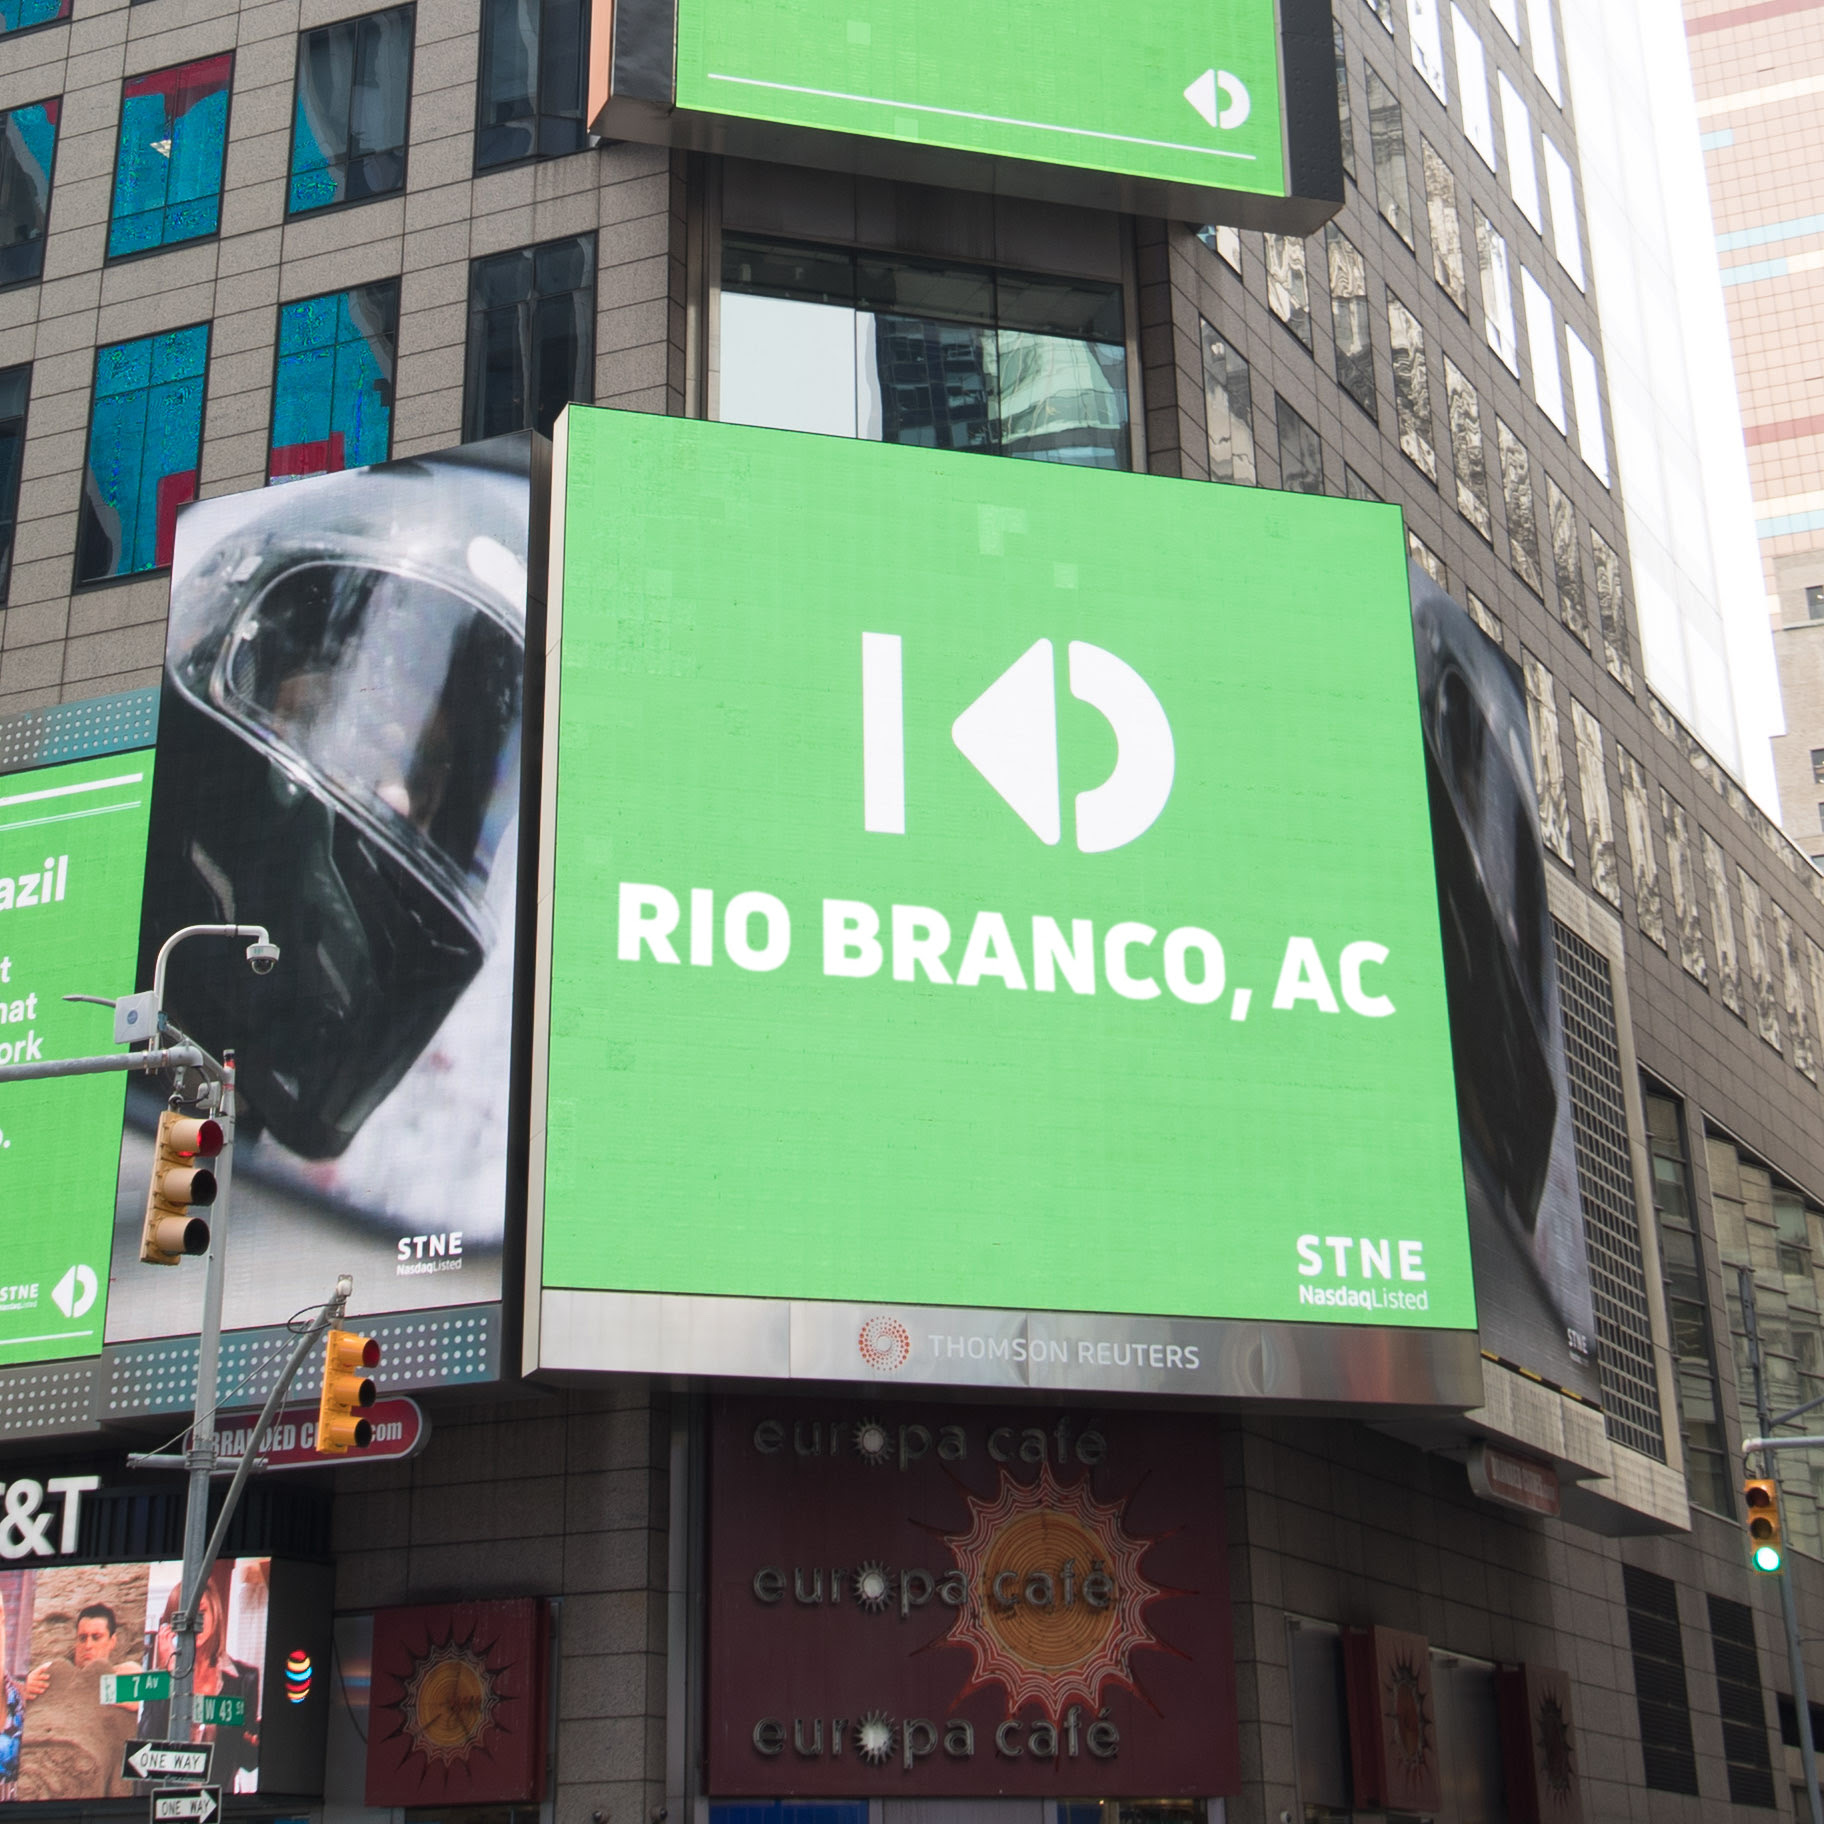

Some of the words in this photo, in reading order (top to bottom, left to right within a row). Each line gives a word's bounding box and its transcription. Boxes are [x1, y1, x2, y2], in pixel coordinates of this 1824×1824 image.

[617, 881, 792, 972] RIO
[822, 896, 1253, 1023] BRANCO,
[1271, 935, 1398, 1019] AC
[396, 1232, 463, 1261] STNE
[1296, 1233, 1428, 1282] STNE
[395, 1258, 463, 1277] NasdaqListed
[0, 1283, 40, 1302] STNE
[1298, 1283, 1430, 1312] NasdaqListed
[927, 1333, 1070, 1365] THOMSON
[1078, 1340, 1200, 1370] REUTERS
[132, 1676, 141, 1699] 7
[145, 1676, 159, 1690] Av
[205, 1698, 216, 1720] W
[219, 1700, 233, 1722] 43
[995, 1705, 1120, 1758] café
[140, 1753, 166, 1770] ONE
[176, 1754, 201, 1770] WAY
[161, 1800, 181, 1816] ONE
[190, 1798, 212, 1814] WAY
